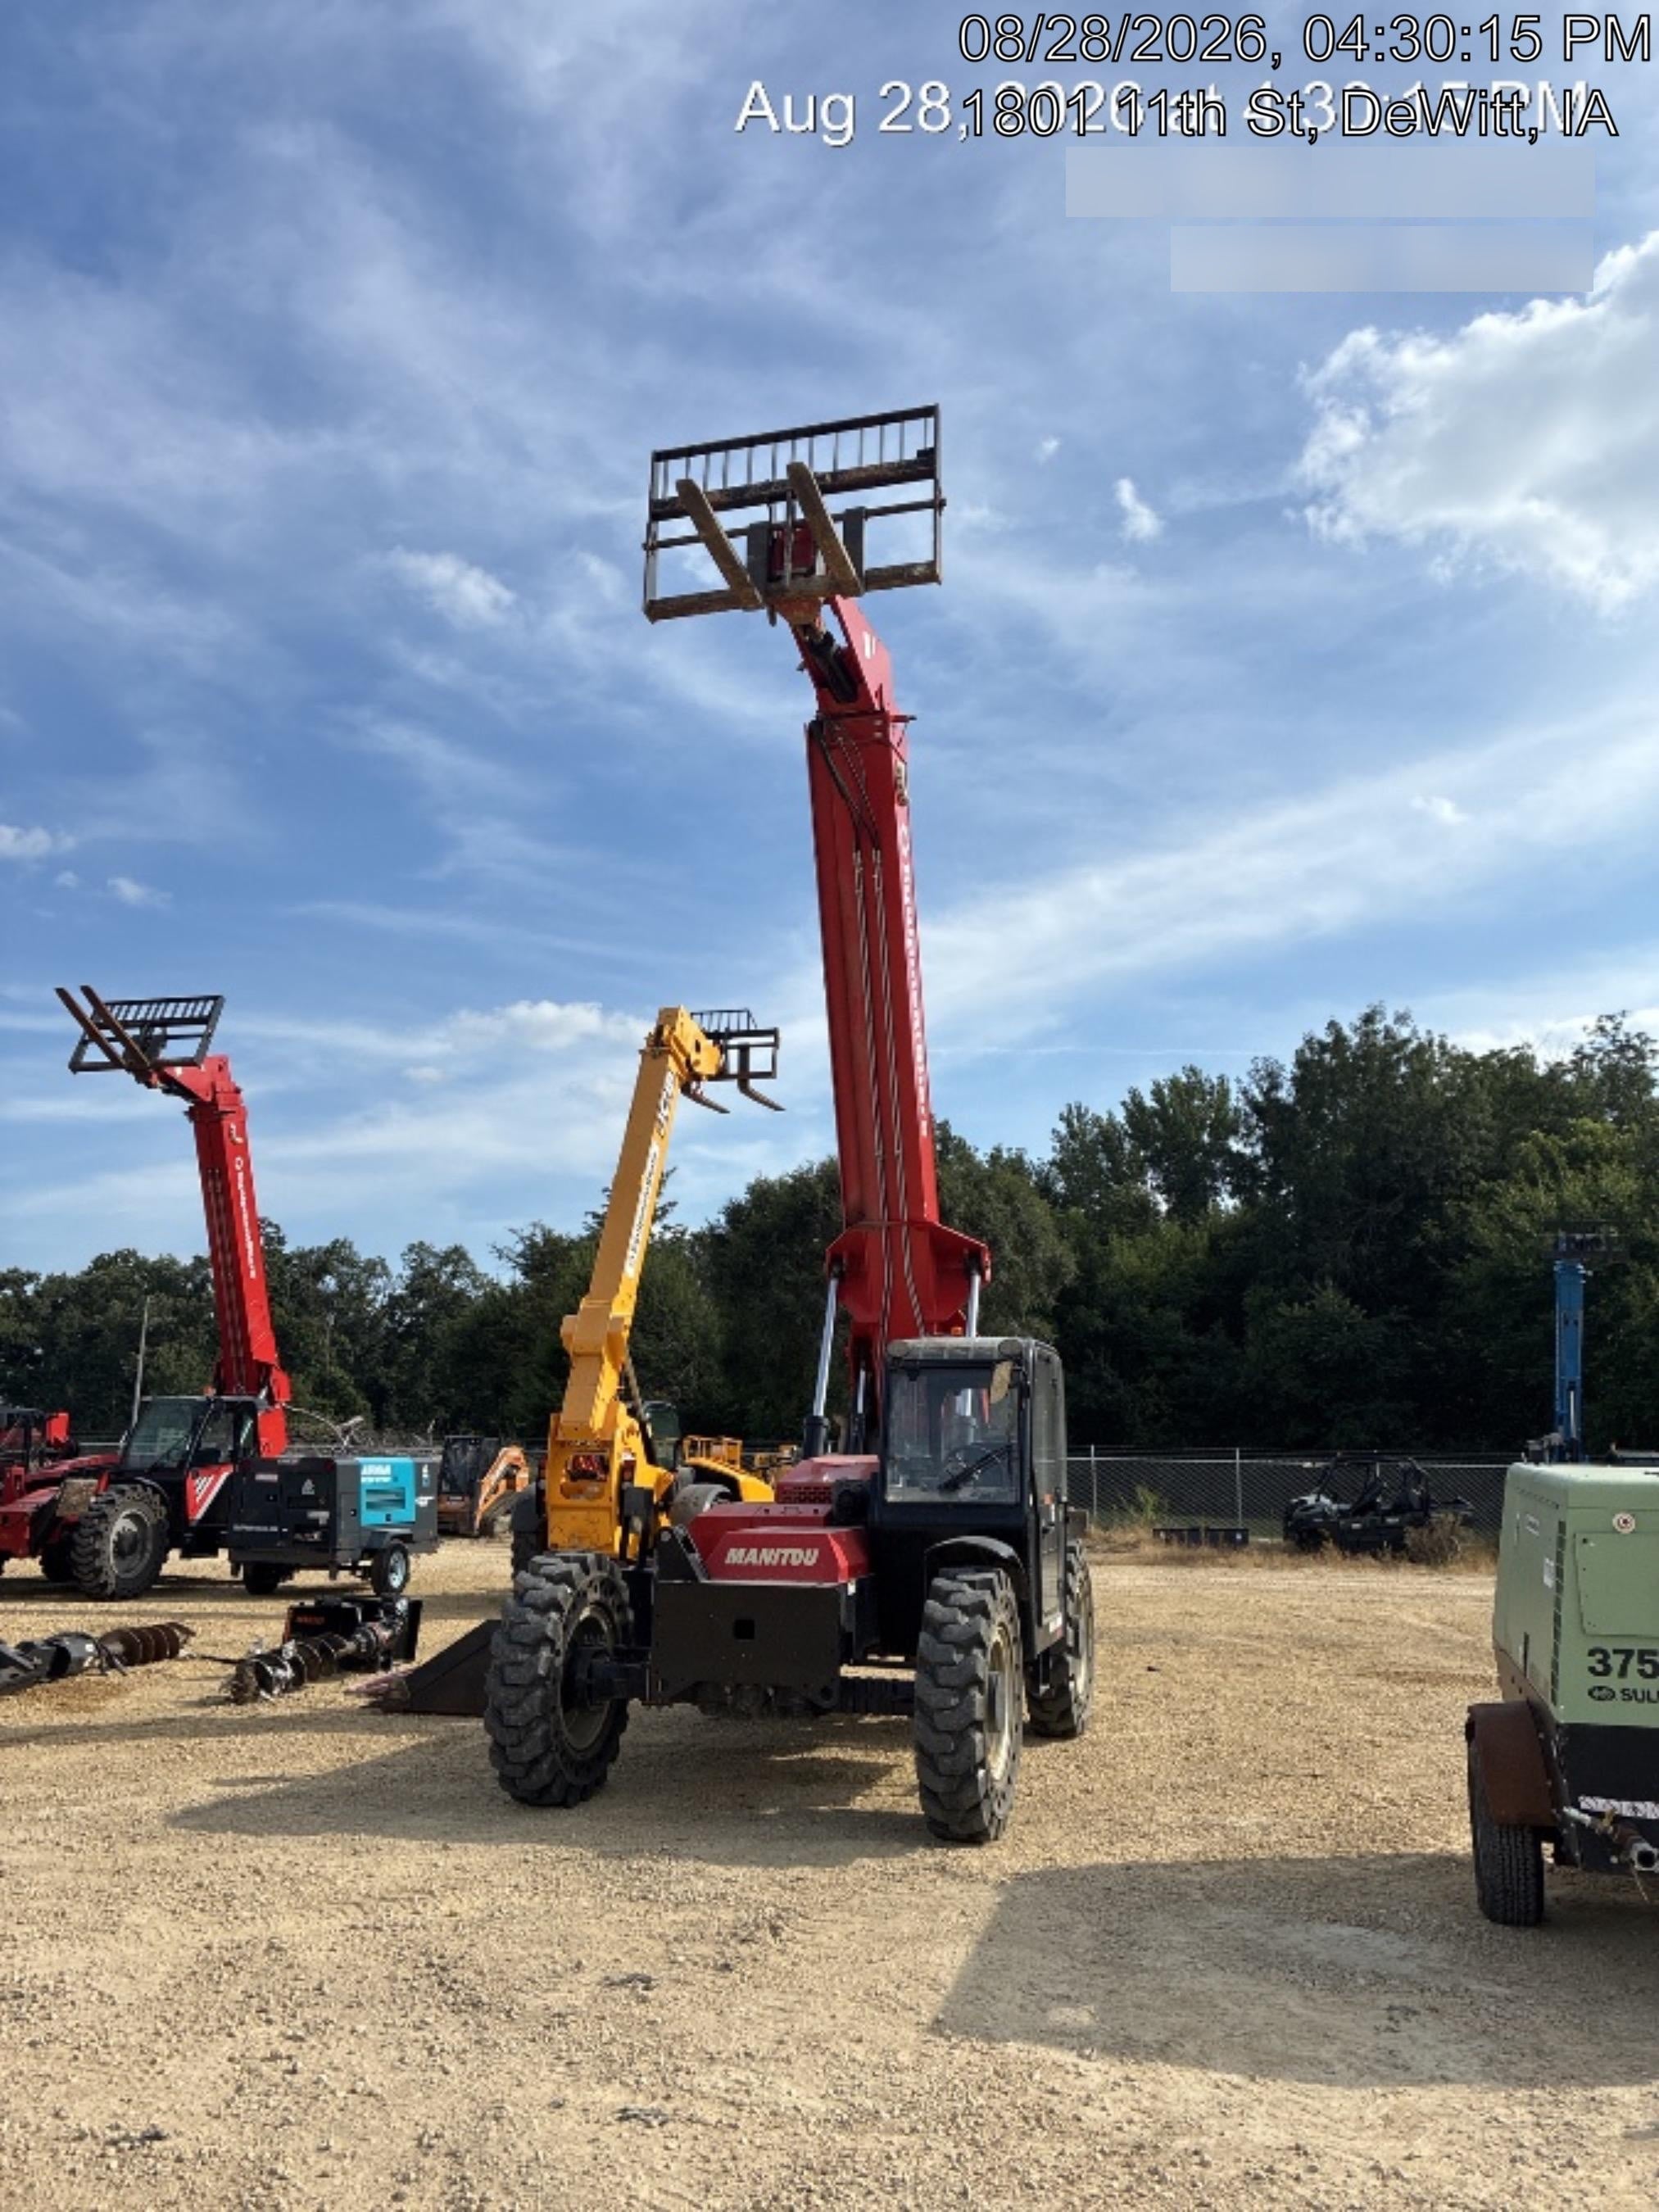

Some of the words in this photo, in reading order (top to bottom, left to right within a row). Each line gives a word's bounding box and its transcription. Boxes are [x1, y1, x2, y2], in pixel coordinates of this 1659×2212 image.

[724, 1548, 819, 1566] MANITOU
[1587, 1646, 1659, 1679] 375
[1620, 1688, 1659, 1704] SUL
